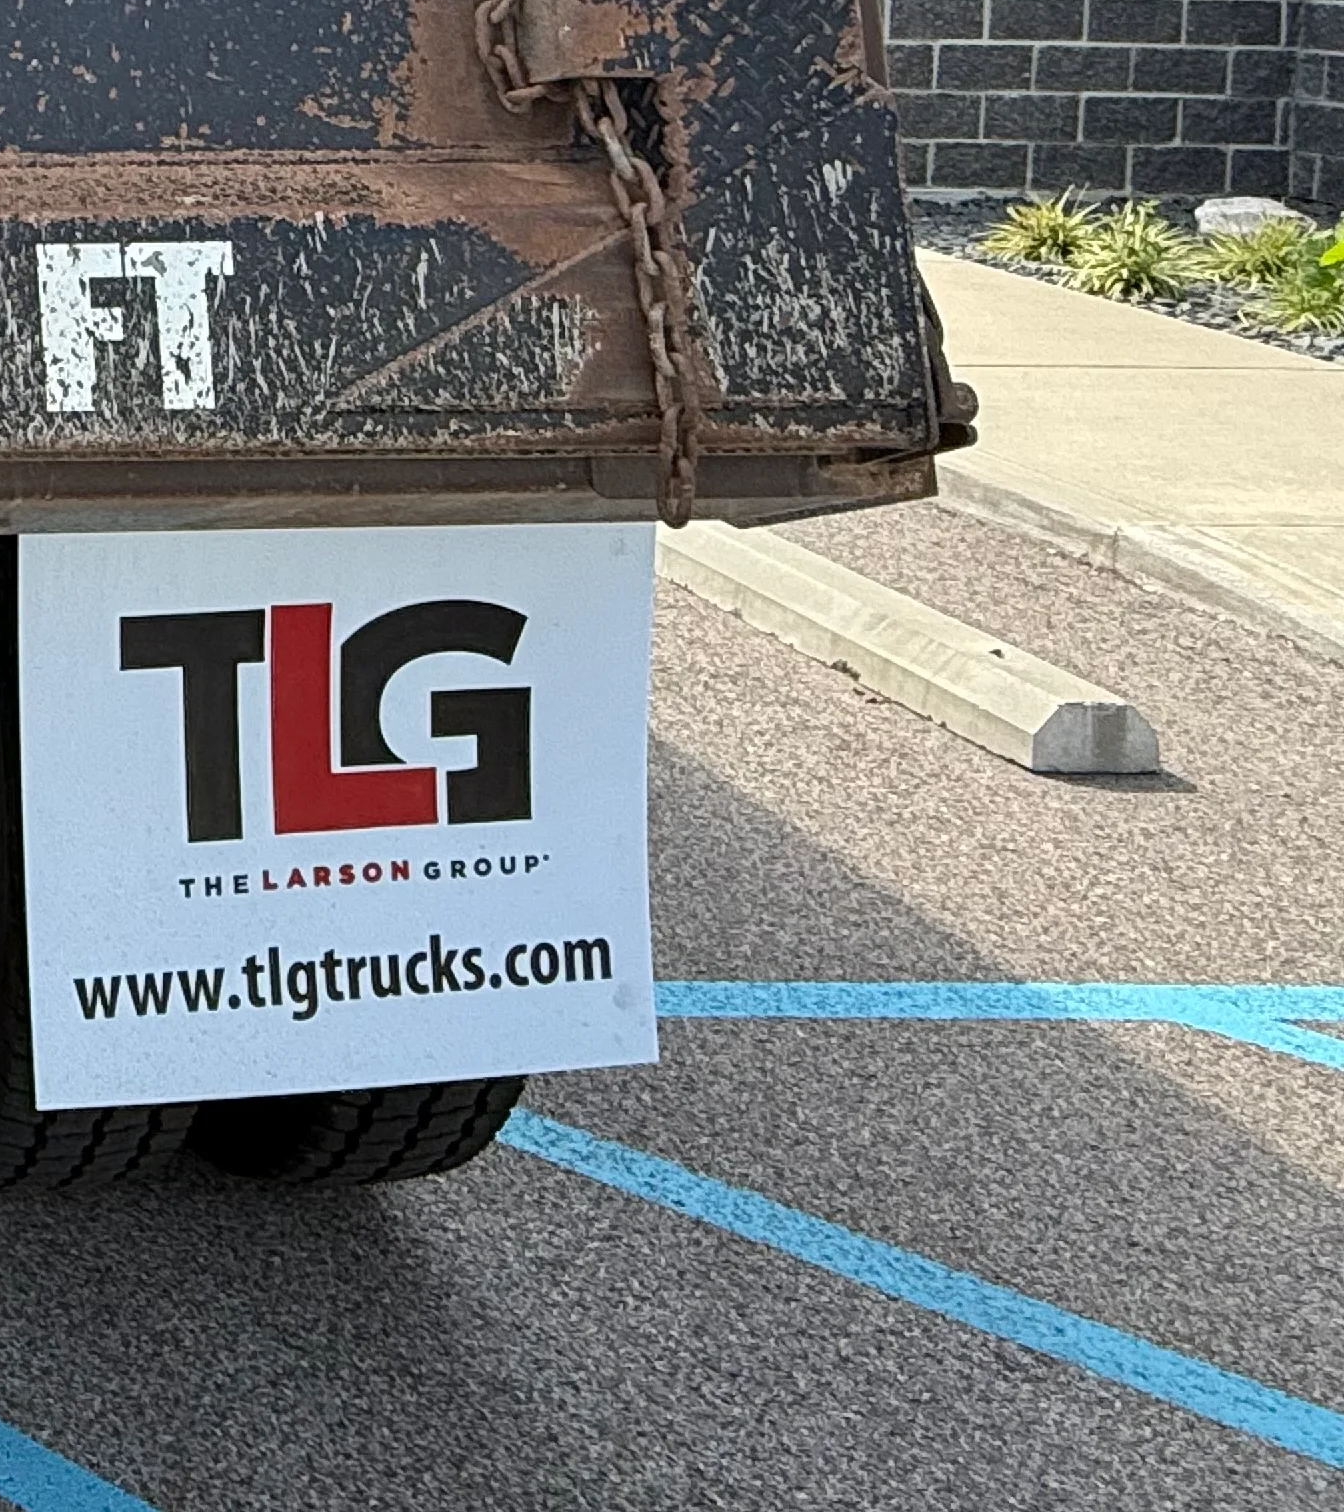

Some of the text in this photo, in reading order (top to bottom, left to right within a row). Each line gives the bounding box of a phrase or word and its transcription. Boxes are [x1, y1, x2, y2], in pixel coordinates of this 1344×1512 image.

[36, 240, 235, 413] FT
[119, 599, 533, 843] TLG
[178, 854, 542, 899] THE LARSON GROUP
[73, 934, 613, 1021] www.tlgtrucks.com
